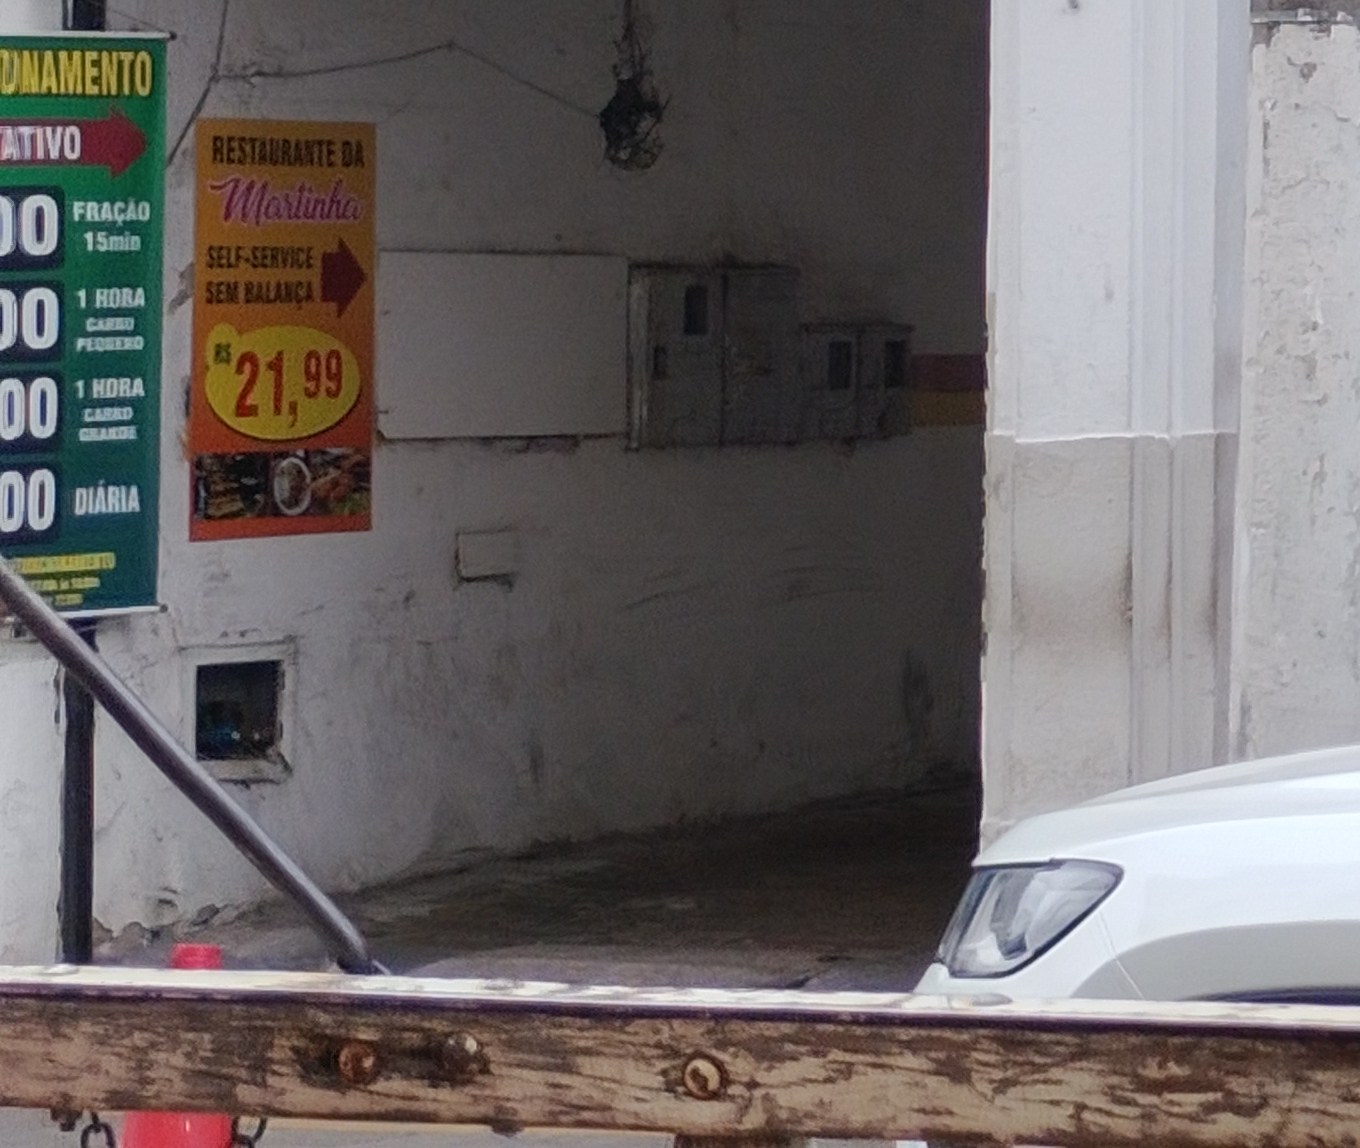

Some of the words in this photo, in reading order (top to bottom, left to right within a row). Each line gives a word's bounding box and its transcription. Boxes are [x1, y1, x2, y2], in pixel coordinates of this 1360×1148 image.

[212, 135, 337, 167] RESTAURANTE
[341, 140, 365, 168] DA
[72, 197, 150, 227] FRAÇÃO
[83, 231, 141, 252] 15min
[206, 244, 315, 270] SELF-SERVICE
[77, 289, 86, 308] 1
[95, 287, 145, 308] HORA
[205, 280, 239, 305] SEM
[244, 280, 315, 310] BALANÇA
[75, 380, 85, 399] 1
[92, 377, 145, 398] HORA
[235, 349, 343, 428] 21,99
[74, 479, 141, 515] DIÁRIA
